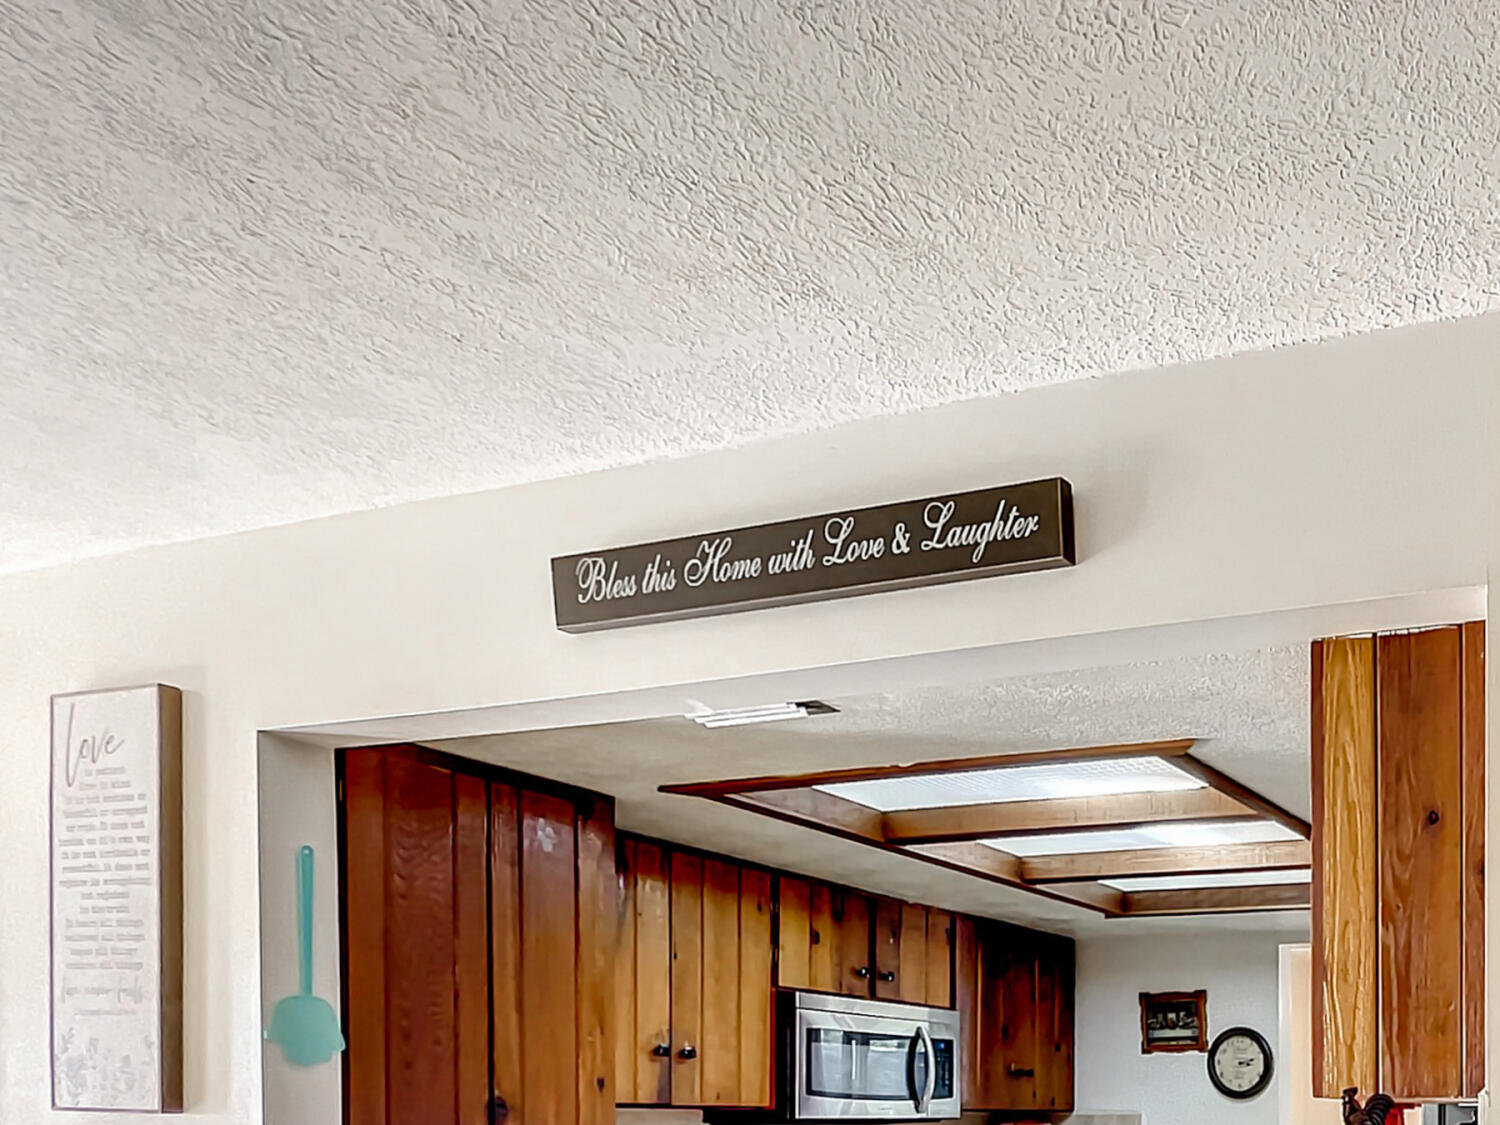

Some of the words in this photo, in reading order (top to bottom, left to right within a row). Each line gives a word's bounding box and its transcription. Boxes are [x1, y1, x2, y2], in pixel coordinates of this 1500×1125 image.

[576, 556, 637, 604] Bless
[641, 553, 677, 595] this
[683, 536, 762, 588] Home
[768, 528, 816, 575] with
[822, 516, 885, 566] Love
[891, 522, 911, 554] &
[920, 499, 1039, 563] Laughter
